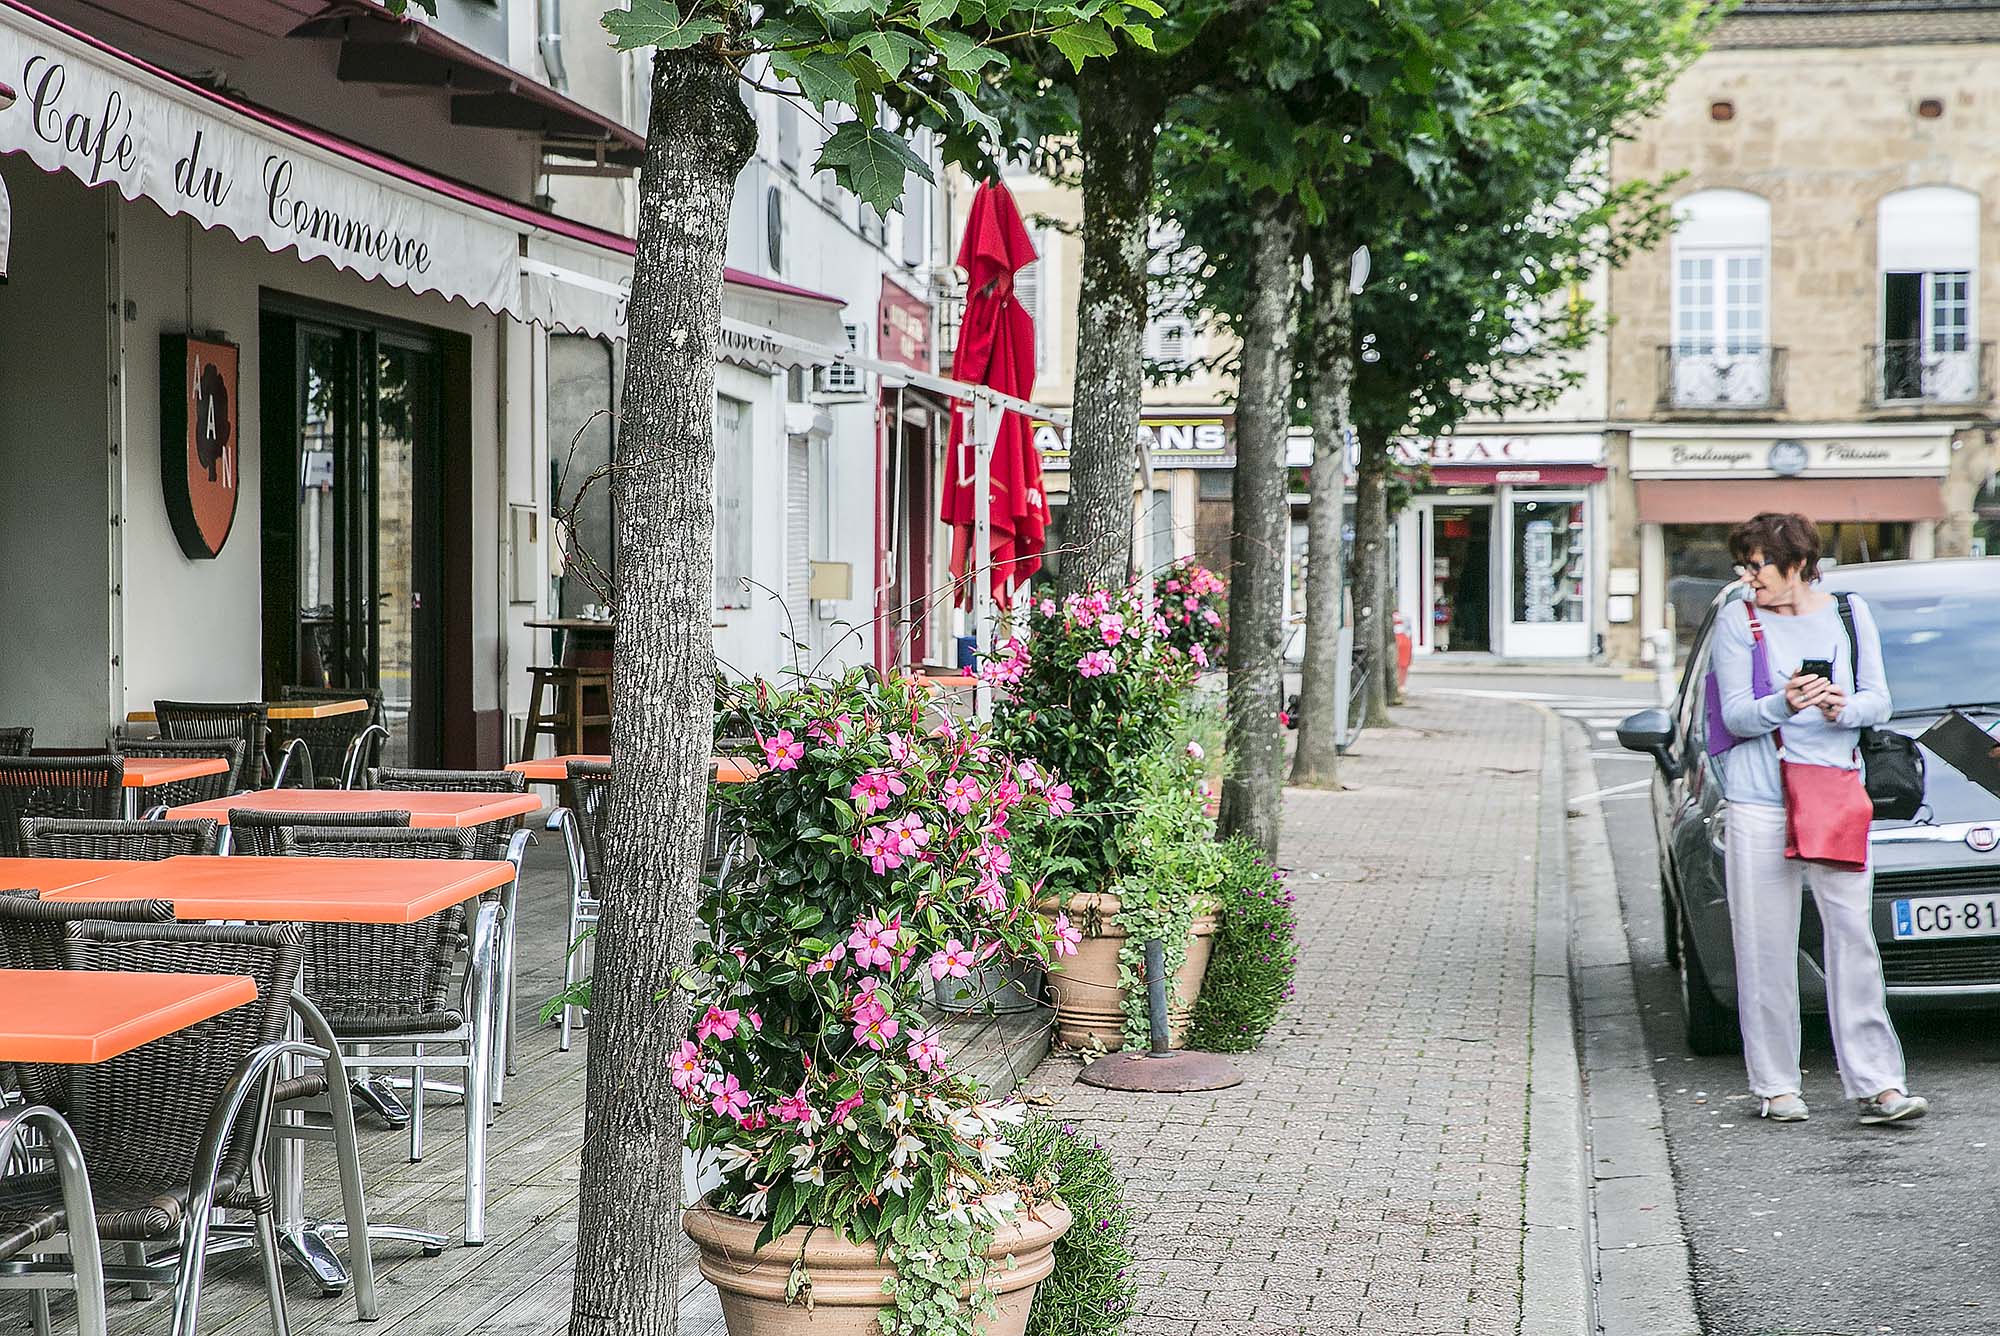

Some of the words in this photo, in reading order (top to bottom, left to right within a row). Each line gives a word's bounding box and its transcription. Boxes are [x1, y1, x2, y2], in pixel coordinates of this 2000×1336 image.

[24, 55, 136, 185] Café
[175, 130, 233, 207] du
[263, 155, 432, 274] Commerce
